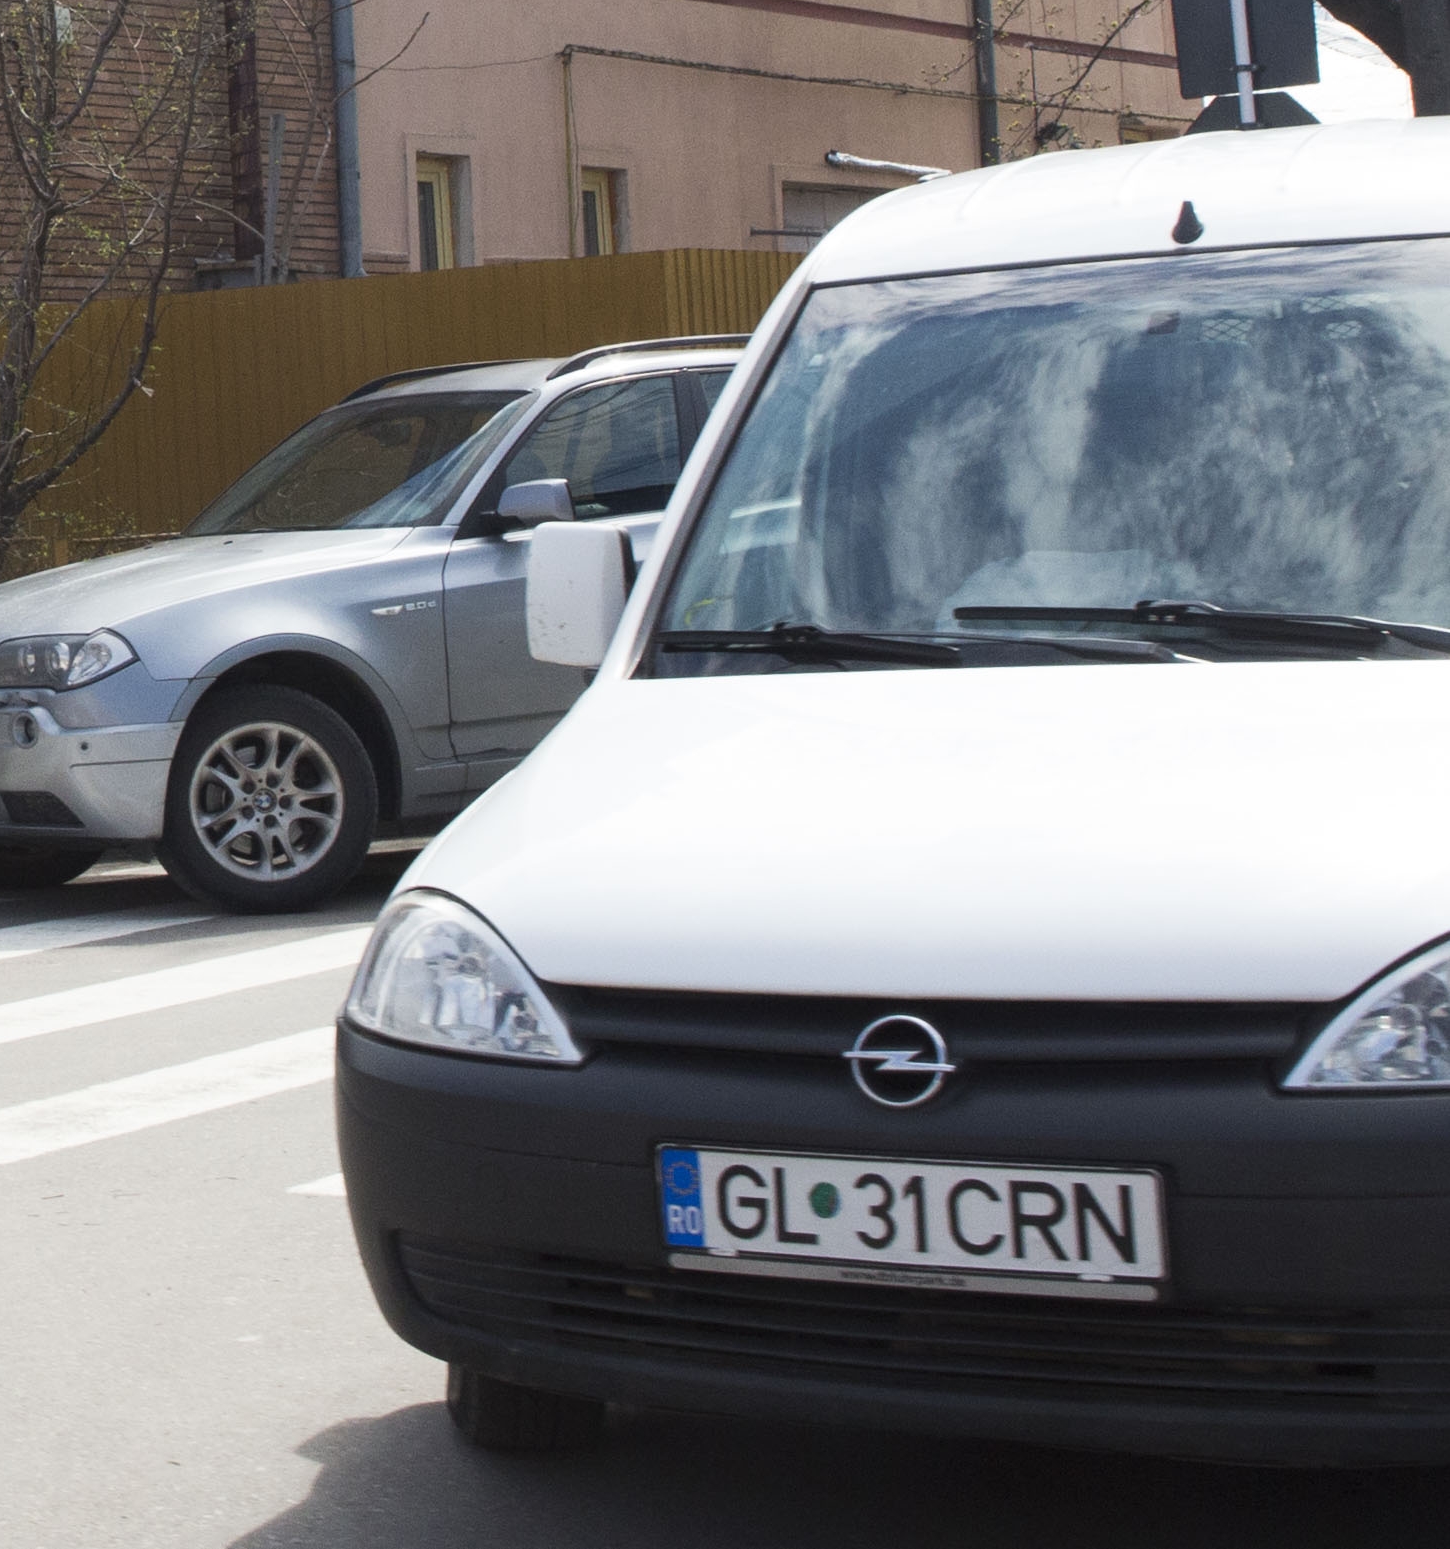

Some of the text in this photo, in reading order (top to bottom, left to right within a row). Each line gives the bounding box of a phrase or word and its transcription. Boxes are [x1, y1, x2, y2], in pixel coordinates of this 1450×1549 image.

[667, 1204, 701, 1235] RO
[716, 1164, 1137, 1264] GL 31CRN
